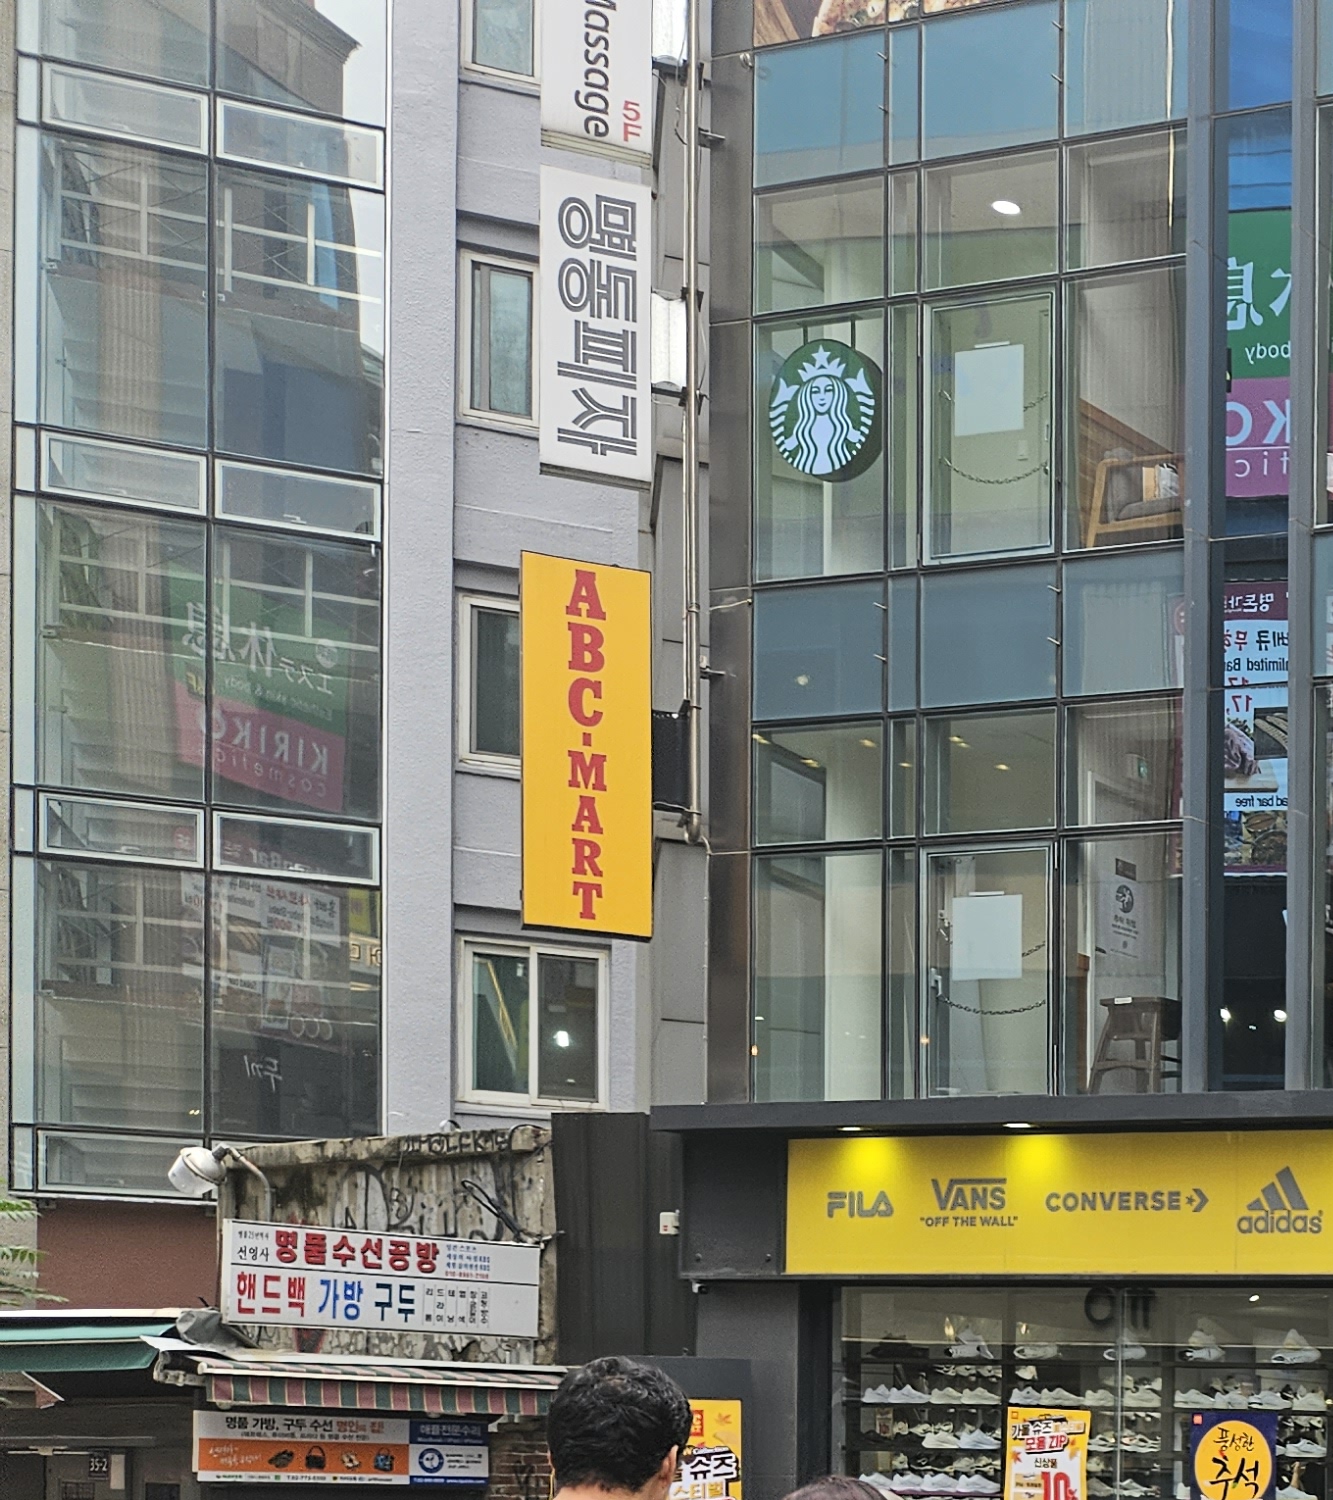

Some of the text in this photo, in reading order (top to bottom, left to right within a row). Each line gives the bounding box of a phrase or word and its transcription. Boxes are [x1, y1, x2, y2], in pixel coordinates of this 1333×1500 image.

[622, 100, 643, 142] 5F
[557, 193, 639, 457] 명동피자
[827, 1190, 895, 1219] FILA
[931, 1177, 1007, 1211] VANS
[1045, 1190, 1182, 1213] CONVERSE
[953, 1215, 978, 1227] THE
[1236, 1207, 1322, 1235] adidas
[275, 1229, 440, 1274] 명품수선공방
[237, 1271, 415, 1323] 핸드백 가방 구두
